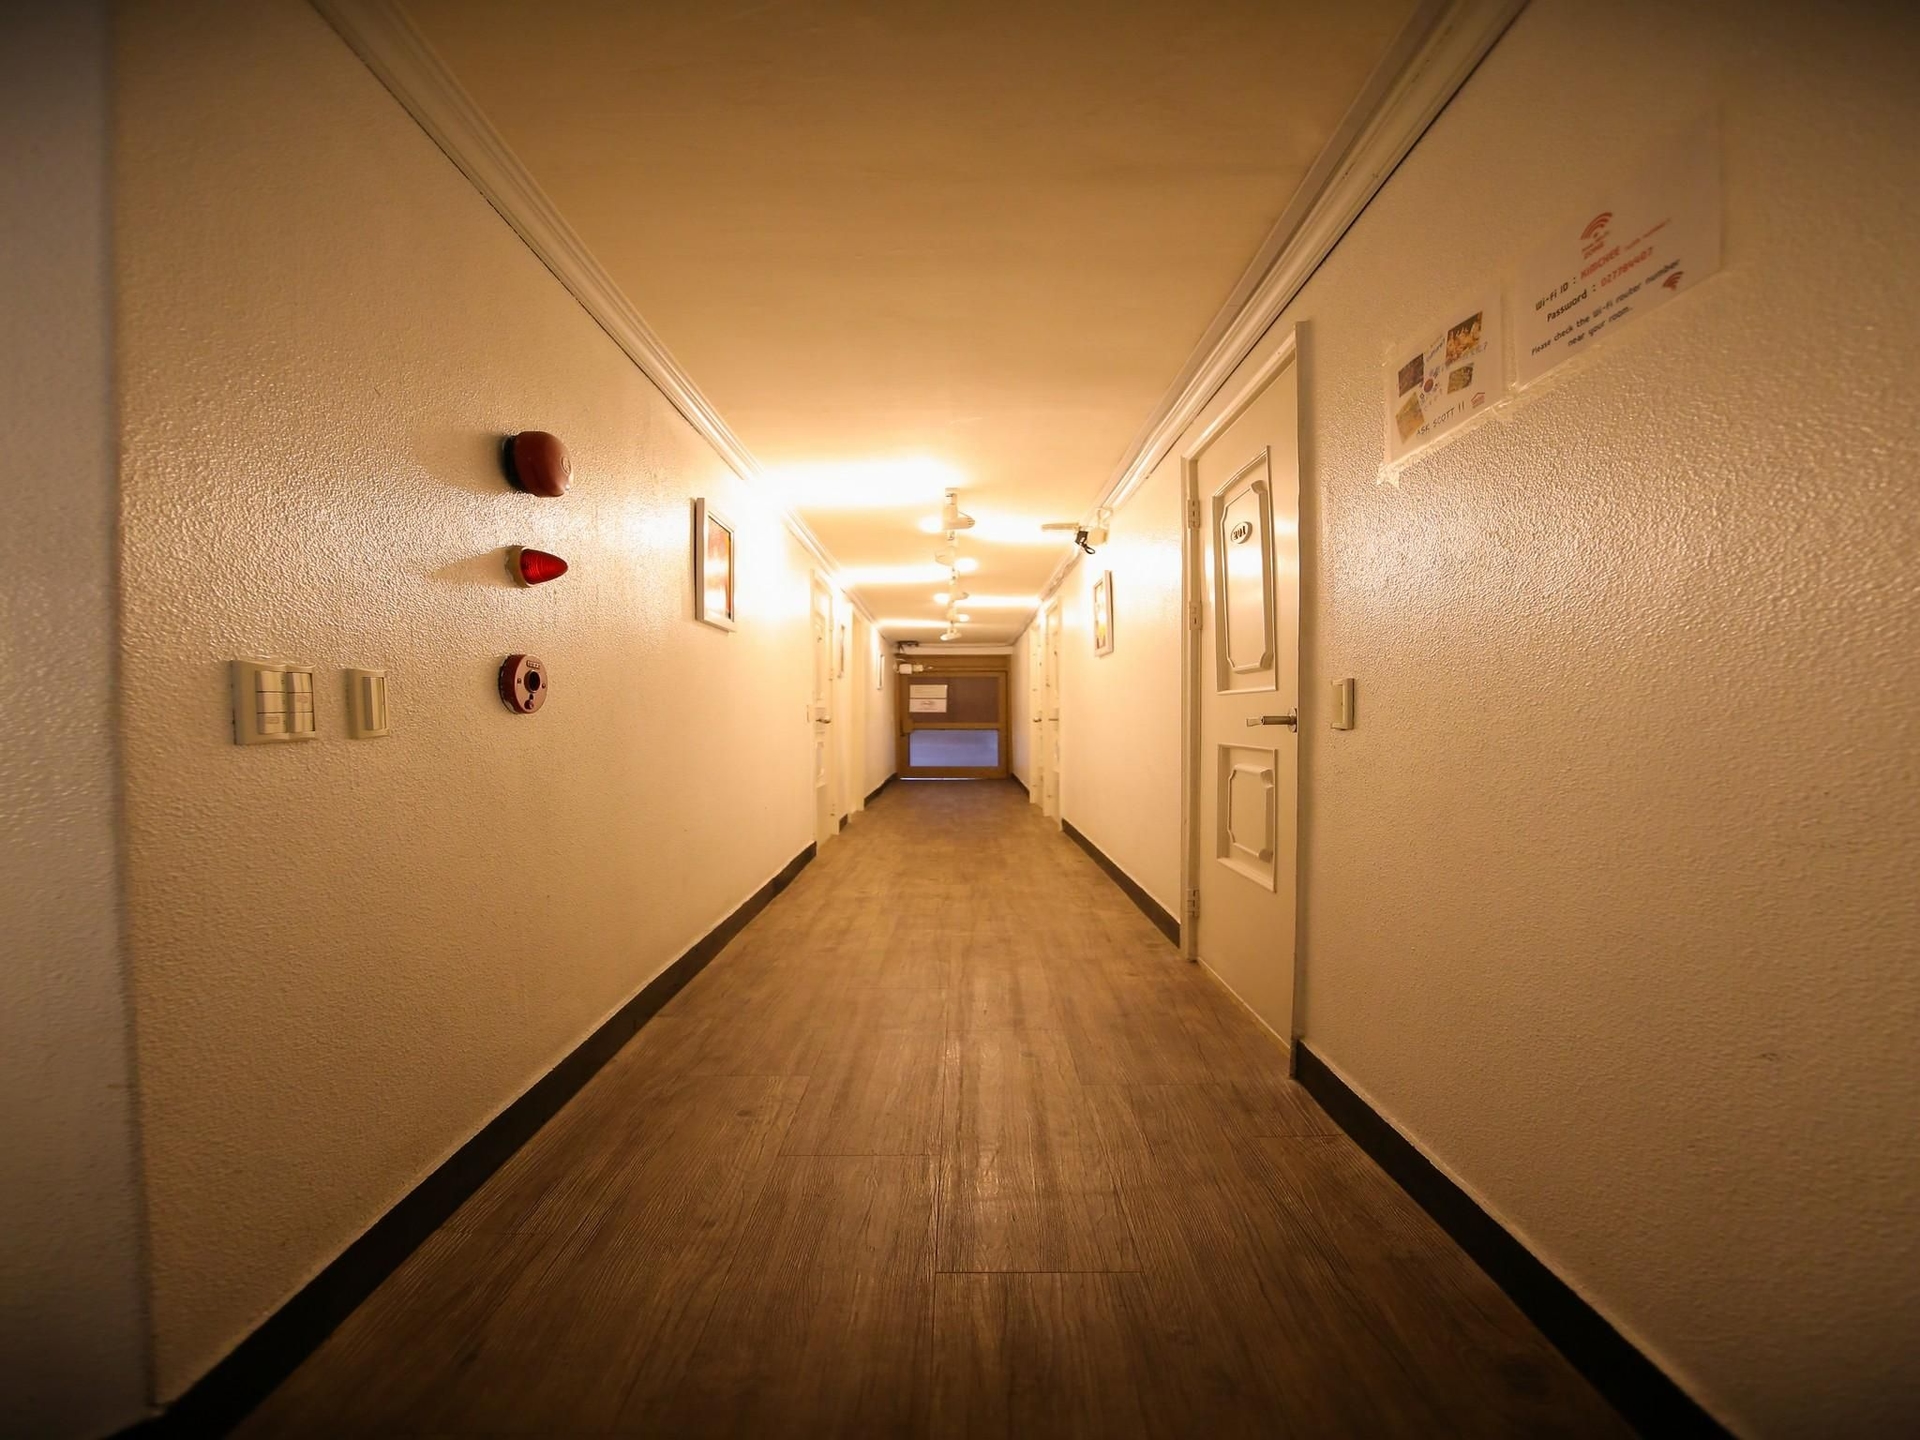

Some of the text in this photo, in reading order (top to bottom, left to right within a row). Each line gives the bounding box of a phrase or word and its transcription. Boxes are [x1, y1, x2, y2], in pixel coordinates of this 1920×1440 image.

[1560, 282, 1569, 294] ID
[1531, 339, 1551, 356] Please
[1554, 325, 1573, 342] check
[1576, 316, 1590, 328] the
[1615, 282, 1642, 303] router
[1645, 258, 1681, 285] number
[1546, 288, 1587, 322] Password
[1568, 332, 1585, 347] near
[1588, 320, 1606, 337] your
[1432, 407, 1455, 428] SCOTT
